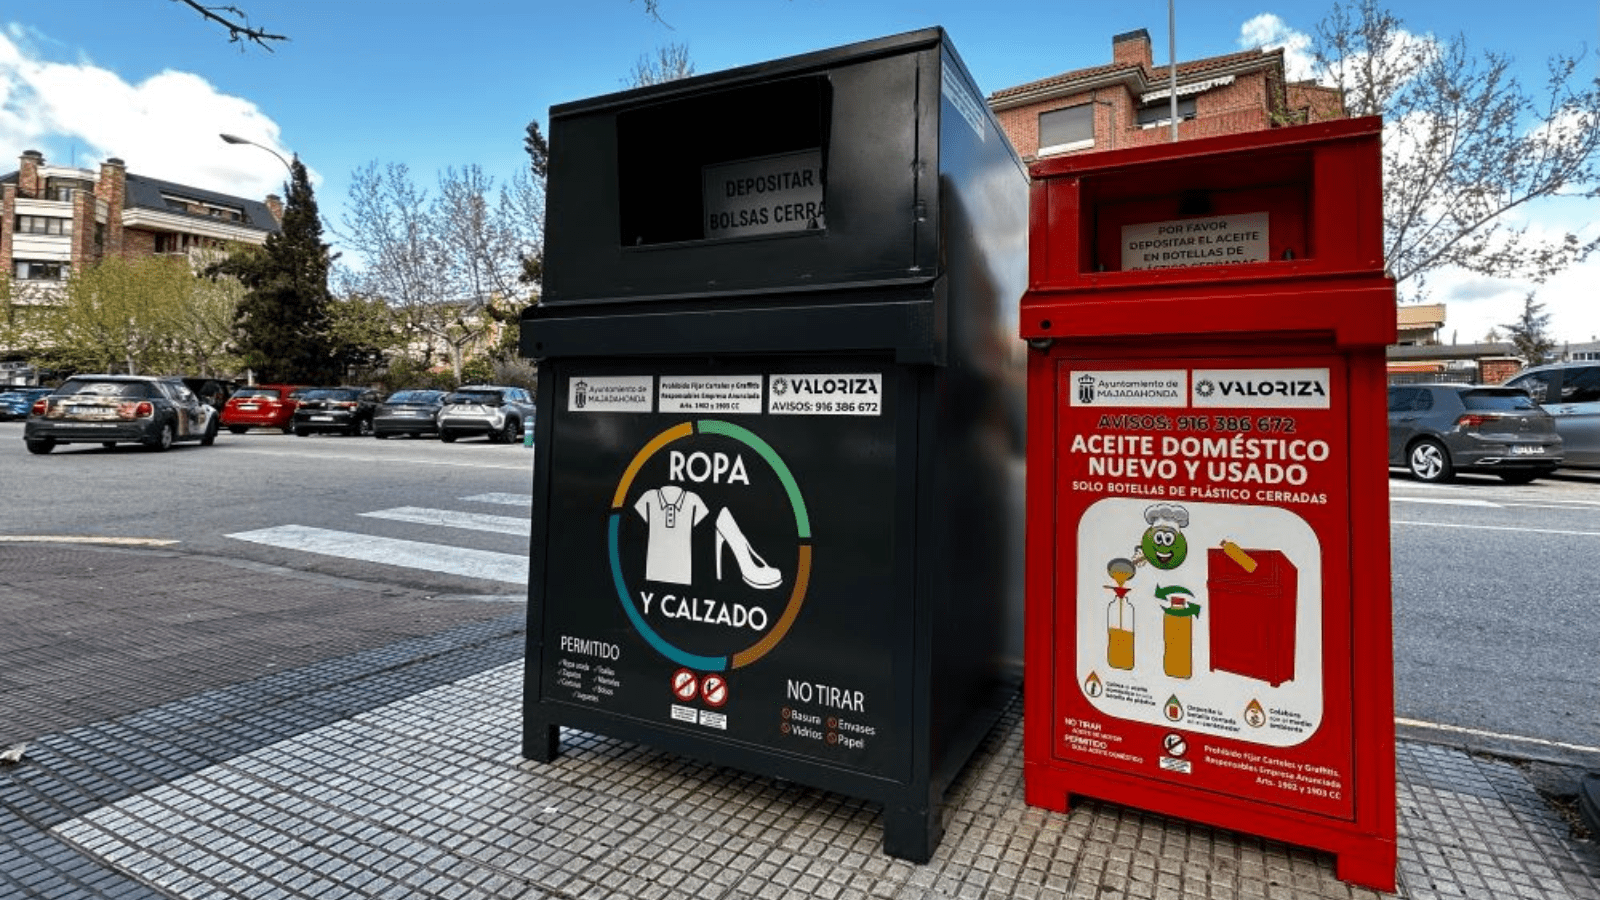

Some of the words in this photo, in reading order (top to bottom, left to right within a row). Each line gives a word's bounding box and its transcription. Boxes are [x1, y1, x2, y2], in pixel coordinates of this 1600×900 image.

[726, 169, 814, 198] DEPOSITAR
[710, 207, 769, 231] BOLSAS
[1158, 225, 1183, 235] POR
[1186, 220, 1228, 233] FAVOR
[1129, 238, 1195, 250] DEPOSITAR
[1198, 235, 1213, 245] EL
[1216, 231, 1260, 244] ACEITE
[1143, 252, 1160, 262] EN
[1162, 247, 1223, 261] BOTELLAS
[1226, 246, 1244, 255] DE
[589, 385, 637, 394] Ayuntamiento
[638, 385, 647, 393] de
[662, 381, 690, 389] Prohibido
[705, 382, 730, 390] Carteles
[791, 379, 877, 394] VALORIZA
[1097, 379, 1164, 390] Ayuntamiento
[1166, 380, 1178, 388] de
[1218, 380, 1326, 396] VALORIZA
[588, 394, 646, 404] MAJADAHONDA
[661, 392, 700, 400] Responsables
[702, 392, 727, 401] Empresa
[728, 392, 760, 400] Anunciada
[1097, 389, 1178, 398] MAJADAHONDA
[772, 401, 813, 412] AVISOS:
[815, 402, 833, 412] 916
[835, 402, 855, 412] 386
[858, 402, 878, 412] 672
[1099, 415, 1171, 430] AVISOS:
[1177, 415, 1209, 430] 916
[1215, 416, 1252, 431] 386
[1257, 417, 1296, 433] 672
[1070, 434, 1154, 455] ACEITE
[1162, 434, 1330, 461] DOMÉSTICO
[669, 450, 750, 485] ROPA
[1088, 457, 1177, 479] NUEVO
[1184, 460, 1200, 480] Y
[1206, 461, 1308, 486] USADO
[1072, 481, 1103, 492] SOLO
[1107, 483, 1165, 496] BOTELLAS
[1169, 486, 1186, 497] DE
[1190, 484, 1251, 500] PLÁSTICO
[1256, 490, 1327, 505] CERRADAS
[640, 591, 654, 614] Y
[660, 594, 767, 631] CALZADO
[561, 635, 620, 661] PERMITIDO
[787, 679, 813, 703] NO
[815, 684, 865, 713] TIRAR
[791, 709, 822, 725] Basura
[1065, 717, 1078, 727] NO
[1079, 719, 1102, 731] TIRAR
[791, 724, 823, 740] Vidrios
[838, 718, 876, 736] Envases
[837, 733, 864, 749] Papel
[1064, 734, 1108, 749] PERMITIDO
[1204, 744, 1242, 759] Prohibido
[1262, 756, 1296, 769] Carteles
[1297, 763, 1303, 772] y
[1204, 755, 1258, 772] Responsables
[1259, 765, 1295, 780] Empresa
[1296, 773, 1341, 788] Anunciada
[1256, 776, 1276, 787] Arts.
[1277, 780, 1298, 791] 1902
[1306, 786, 1327, 797] 1903
[1329, 790, 1341, 800] CC
